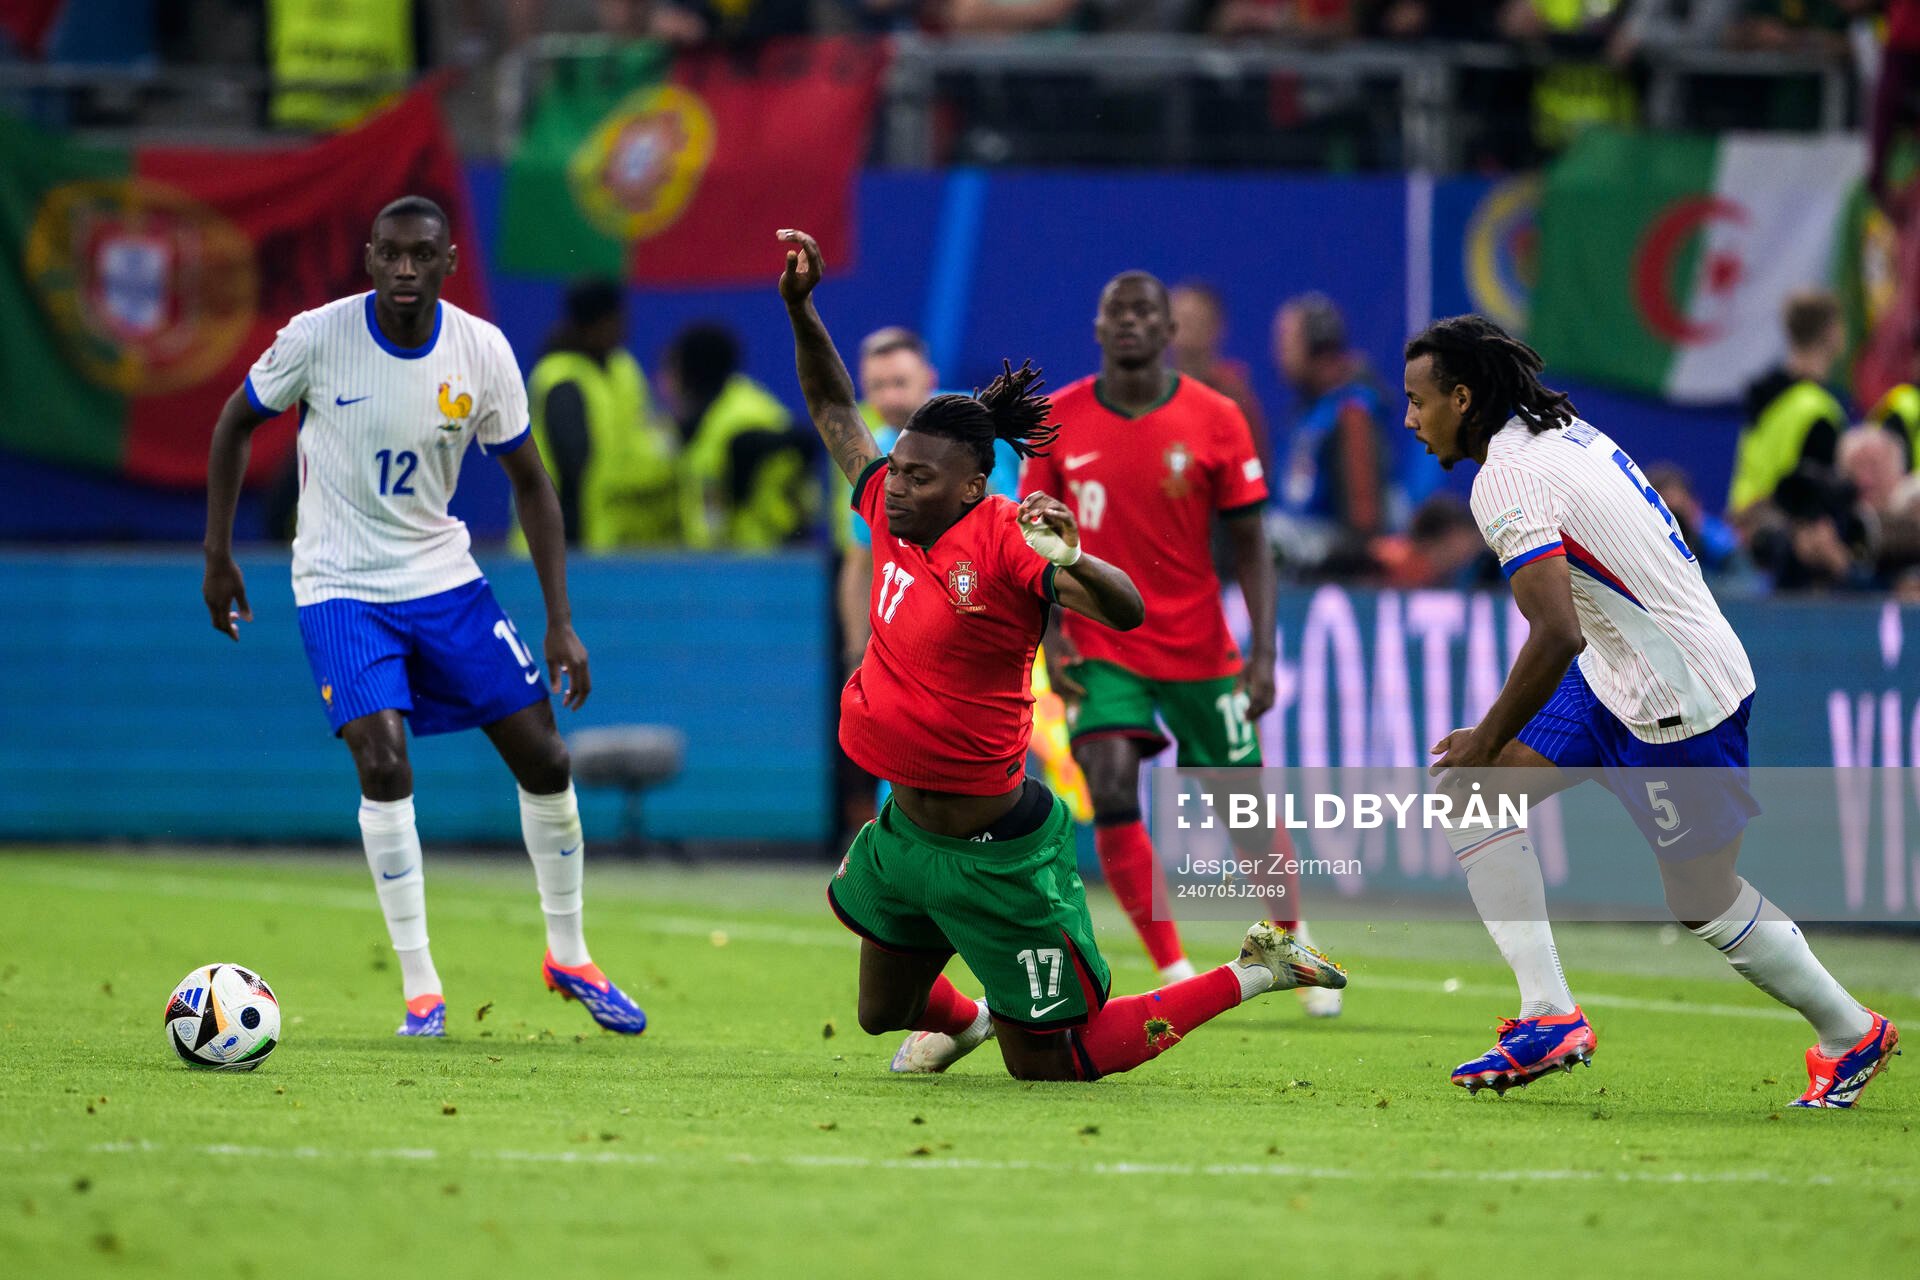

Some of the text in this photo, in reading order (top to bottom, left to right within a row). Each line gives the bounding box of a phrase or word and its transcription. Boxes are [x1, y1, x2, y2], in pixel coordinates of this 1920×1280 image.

[375, 449, 419, 496] 12
[877, 561, 915, 624] 17
[1645, 781, 1680, 830] 5
[1016, 948, 1064, 999] 17
